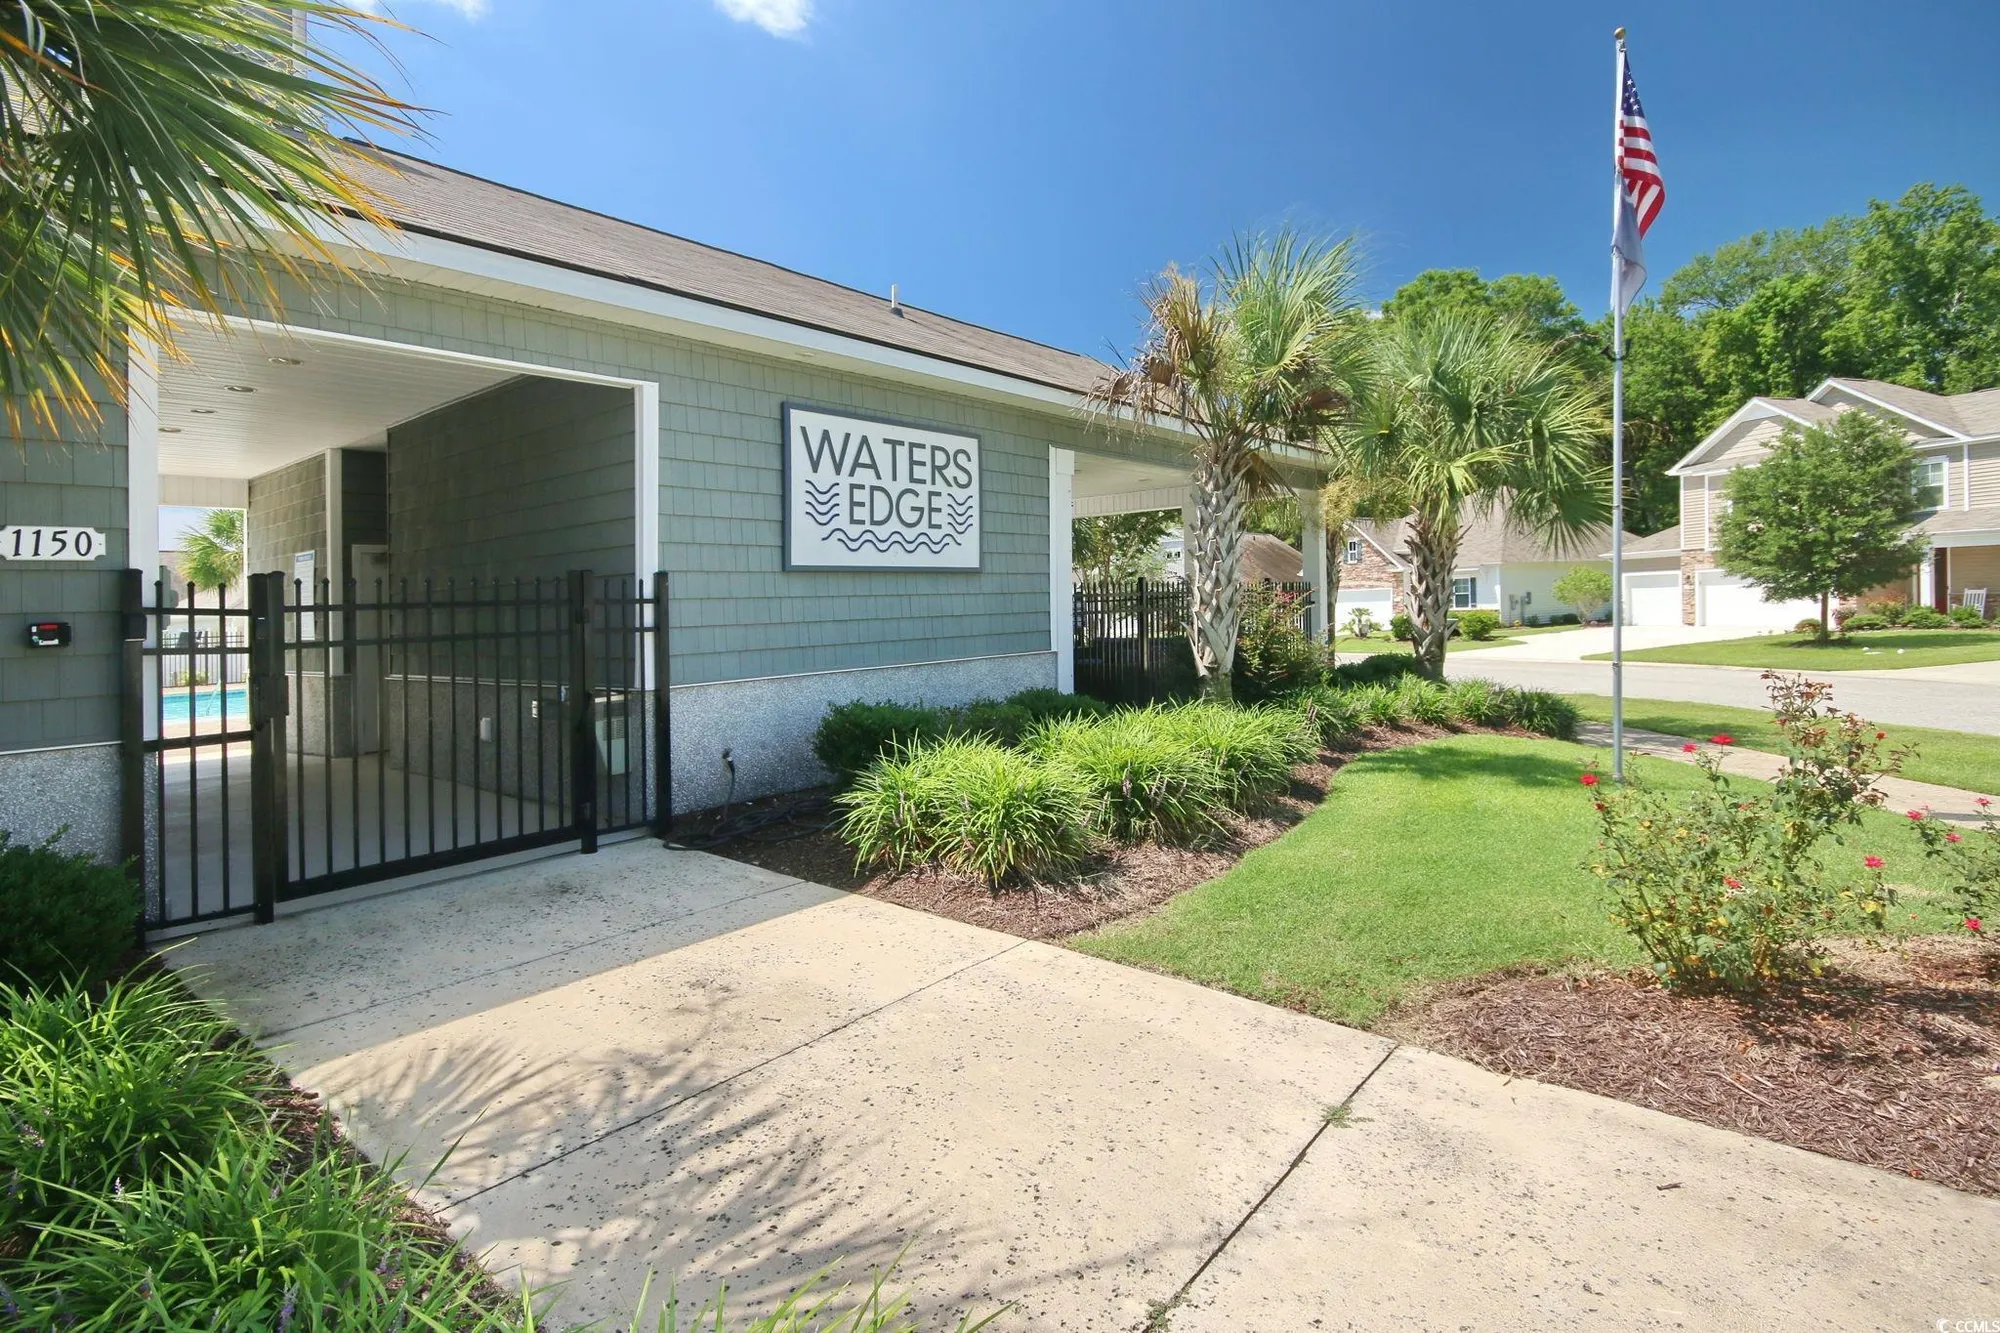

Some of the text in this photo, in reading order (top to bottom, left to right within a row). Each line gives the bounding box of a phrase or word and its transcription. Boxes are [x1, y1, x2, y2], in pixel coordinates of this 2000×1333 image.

[800, 426, 973, 489] WATERS
[849, 483, 942, 530] EDGE
[12, 528, 92, 557] 1150
